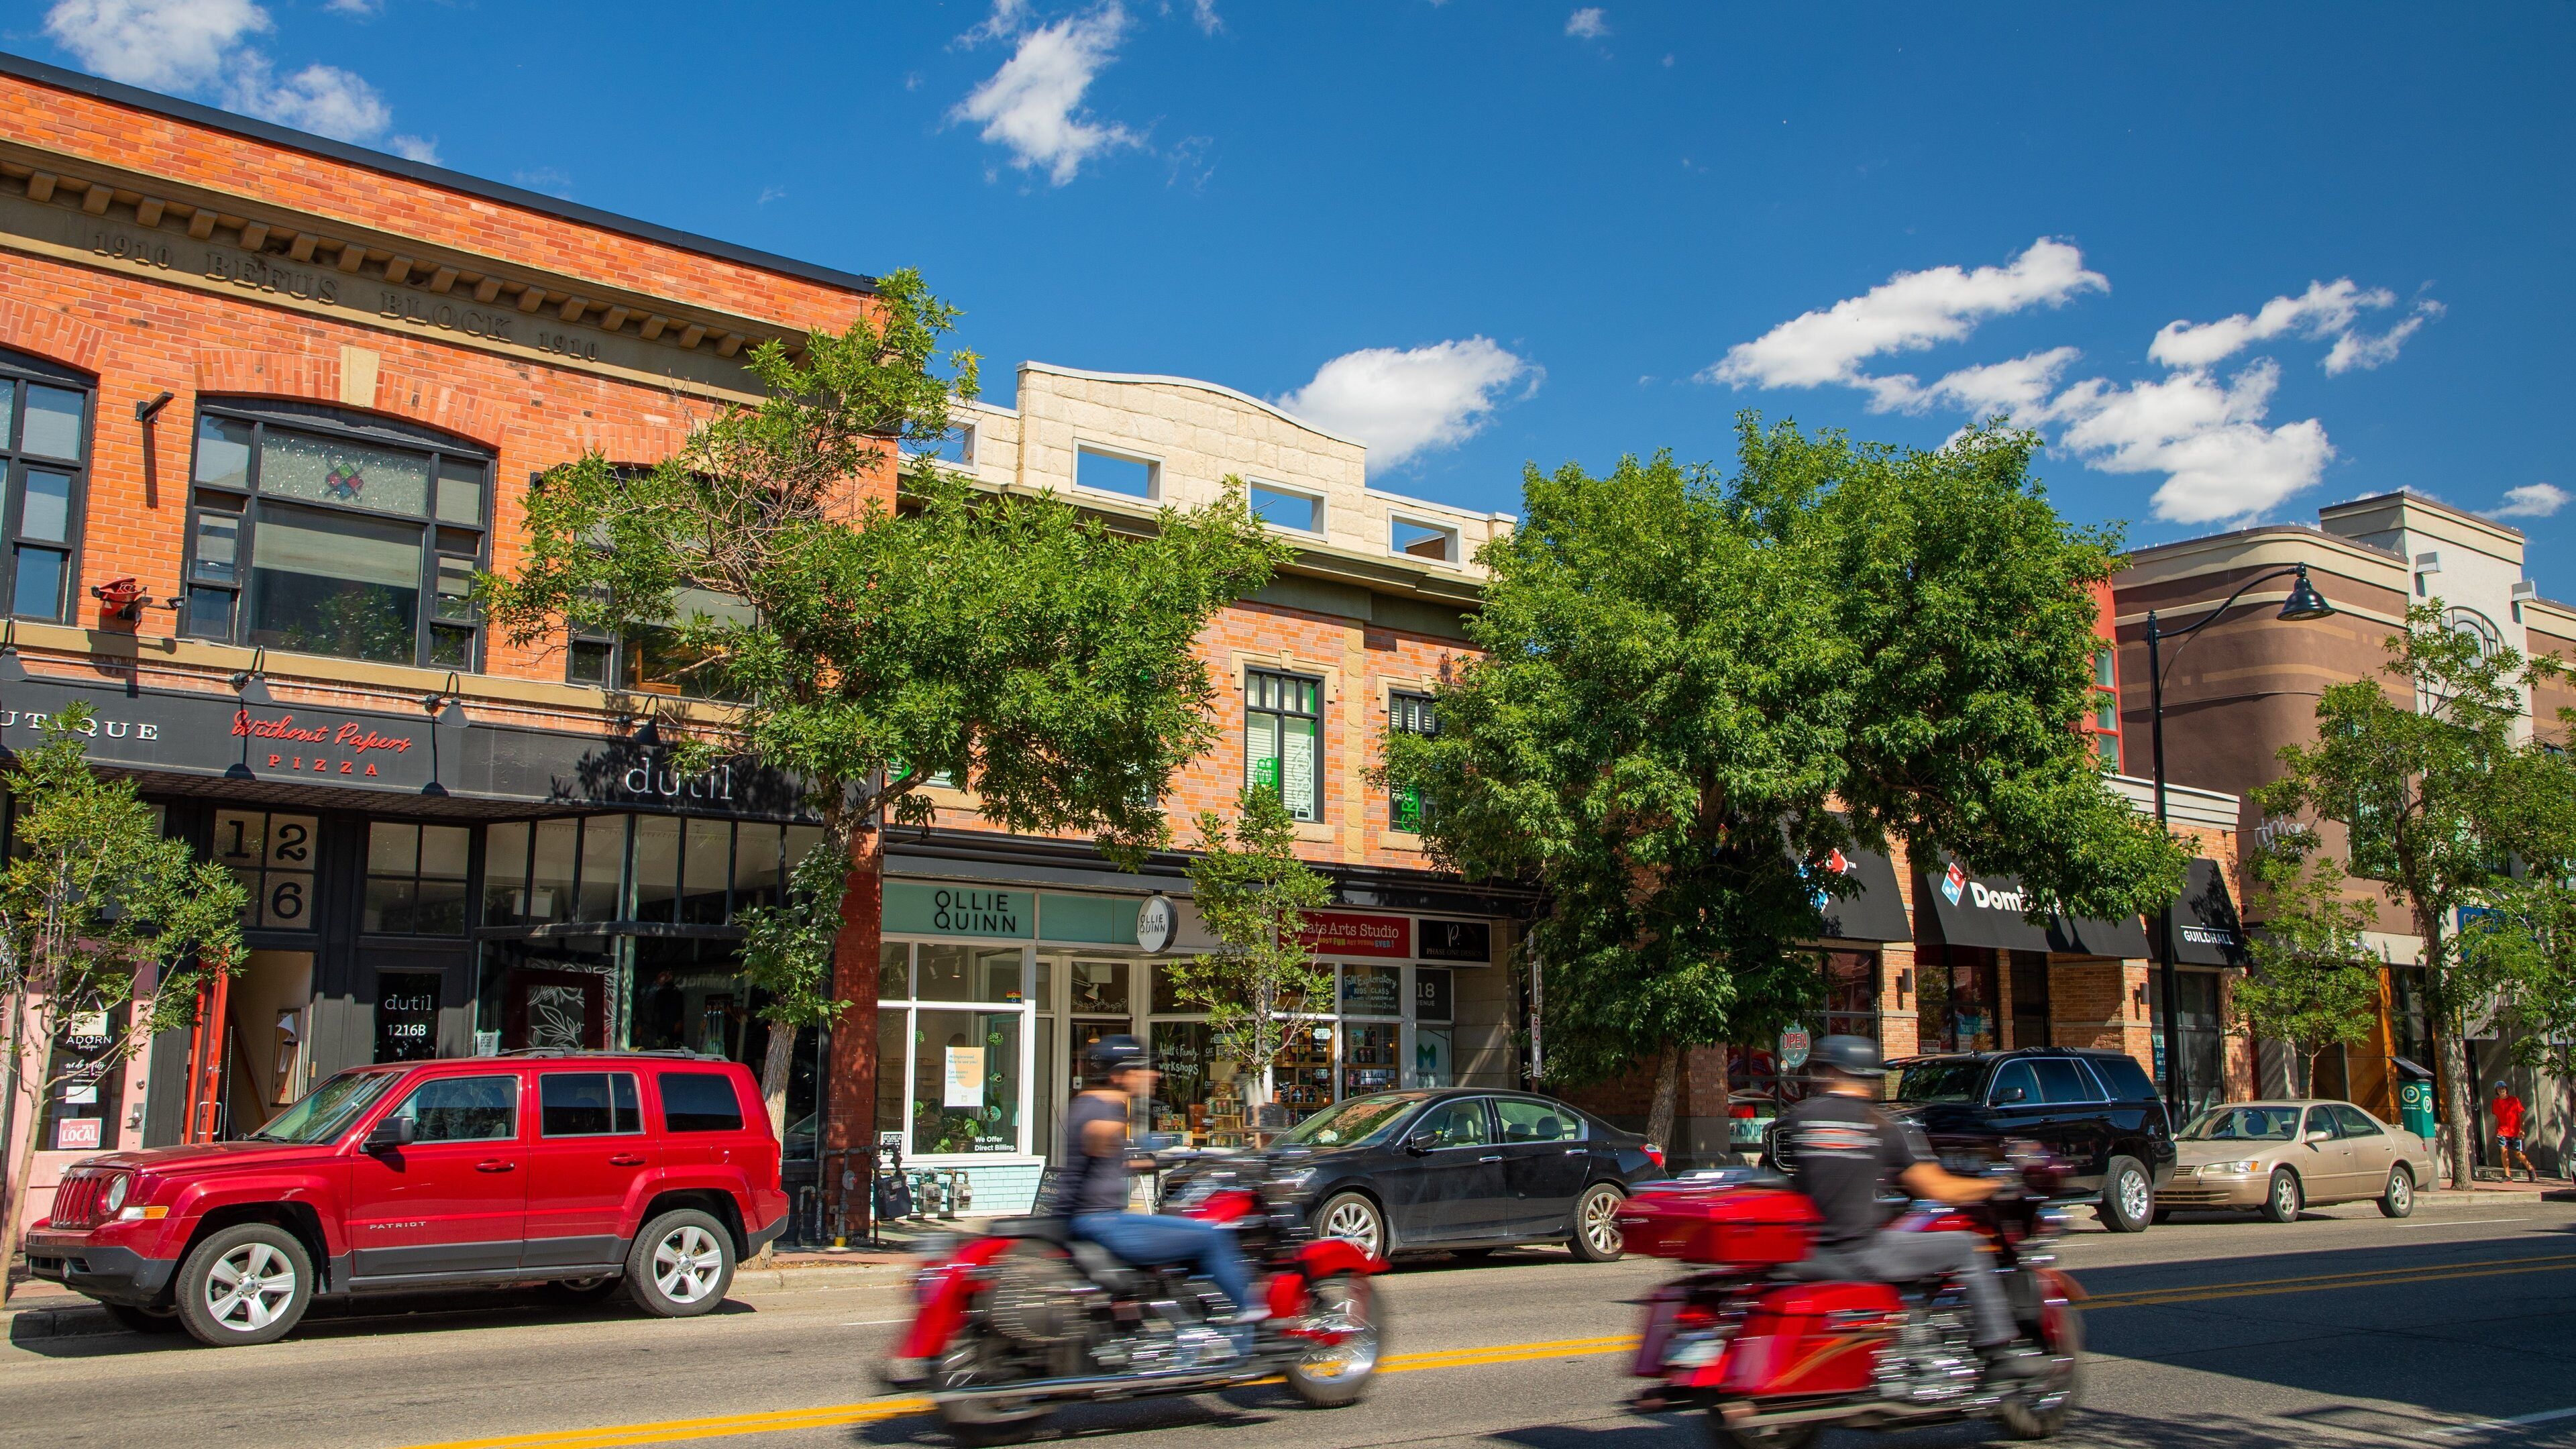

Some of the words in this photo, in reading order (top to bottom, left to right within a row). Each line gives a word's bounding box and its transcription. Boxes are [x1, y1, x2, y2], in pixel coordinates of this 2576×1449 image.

[95, 235, 172, 269] 1910
[205, 252, 337, 305] BEFUS
[380, 292, 512, 343] BLOCK
[539, 331, 600, 363] 1910
[231, 709, 329, 743] Without
[335, 721, 413, 754] Papers
[268, 755, 378, 776] PIZZA
[625, 757, 733, 800] dutil
[935, 890, 1009, 912] OLLIE
[934, 912, 1016, 933] QUINN
[1140, 914, 1164, 923] OLLIE
[1140, 923, 1166, 933] QUINN
[1328, 922, 1356, 936] Arts
[1360, 924, 1399, 938] Studio
[1333, 938, 1346, 947] FUN
[2184, 930, 2235, 945] GUILDHALL
[1344, 975, 1357, 987] Fall
[1358, 973, 1397, 989] Exploratory
[384, 994, 433, 1010] dutil
[388, 1024, 427, 1036] 1216B
[66, 1035, 113, 1044] ADORN
[1782, 1032, 1807, 1050] OPEN
[1159, 1042, 1175, 1058] Adult
[1180, 1044, 1199, 1061] Family
[1159, 1061, 1199, 1075] workshops
[62, 1128, 97, 1142] LOCAL
[1736, 1124, 1752, 1137] NOW
[1754, 1124, 1763, 1137] OP
[975, 1143, 994, 1151] Direct
[995, 1142, 1016, 1152] Billing.
[370, 1221, 427, 1230] PATRIOT
